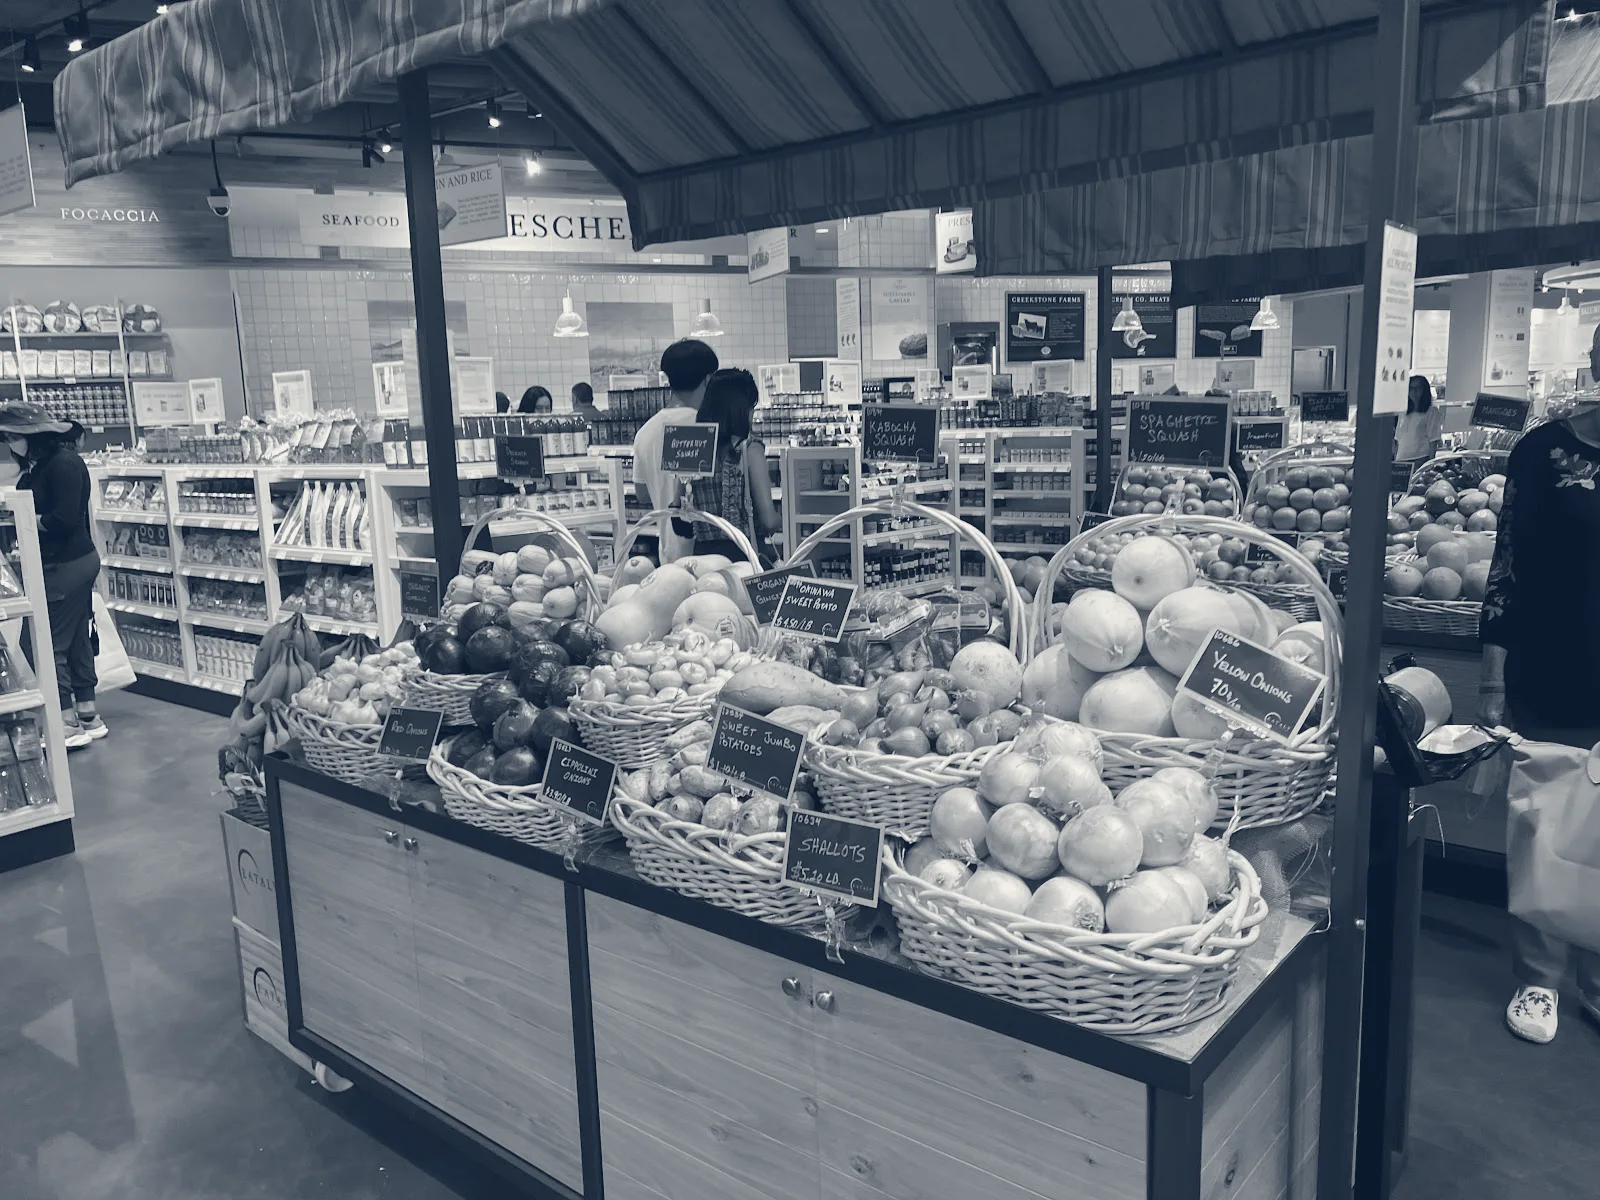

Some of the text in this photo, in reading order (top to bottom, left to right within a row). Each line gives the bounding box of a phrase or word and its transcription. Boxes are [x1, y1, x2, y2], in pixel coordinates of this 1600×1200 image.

[448, 174, 468, 188] AND
[470, 168, 492, 183] RICE
[60, 207, 160, 222] FOCACCIA
[322, 213, 400, 228] SEAFOOD
[869, 420, 917, 434] KABOCHA
[1139, 414, 1219, 430] SPAGHETTI
[671, 438, 708, 449] BUTTERNUT
[872, 432, 916, 447] SQUASH
[1147, 428, 1200, 443] SQUASH
[675, 449, 700, 459] SQUASH
[799, 584, 836, 599] OKINAWA
[784, 595, 839, 612] SWEET POTATO
[1212, 650, 1294, 705] YELLOW ONIONS
[391, 720, 429, 736] RED ONIONS
[718, 731, 763, 757] POTATOES
[721, 720, 797, 753] SWEET JUMBO
[563, 771, 593, 787] ONIONS
[797, 837, 866, 863] SHALLOTS
